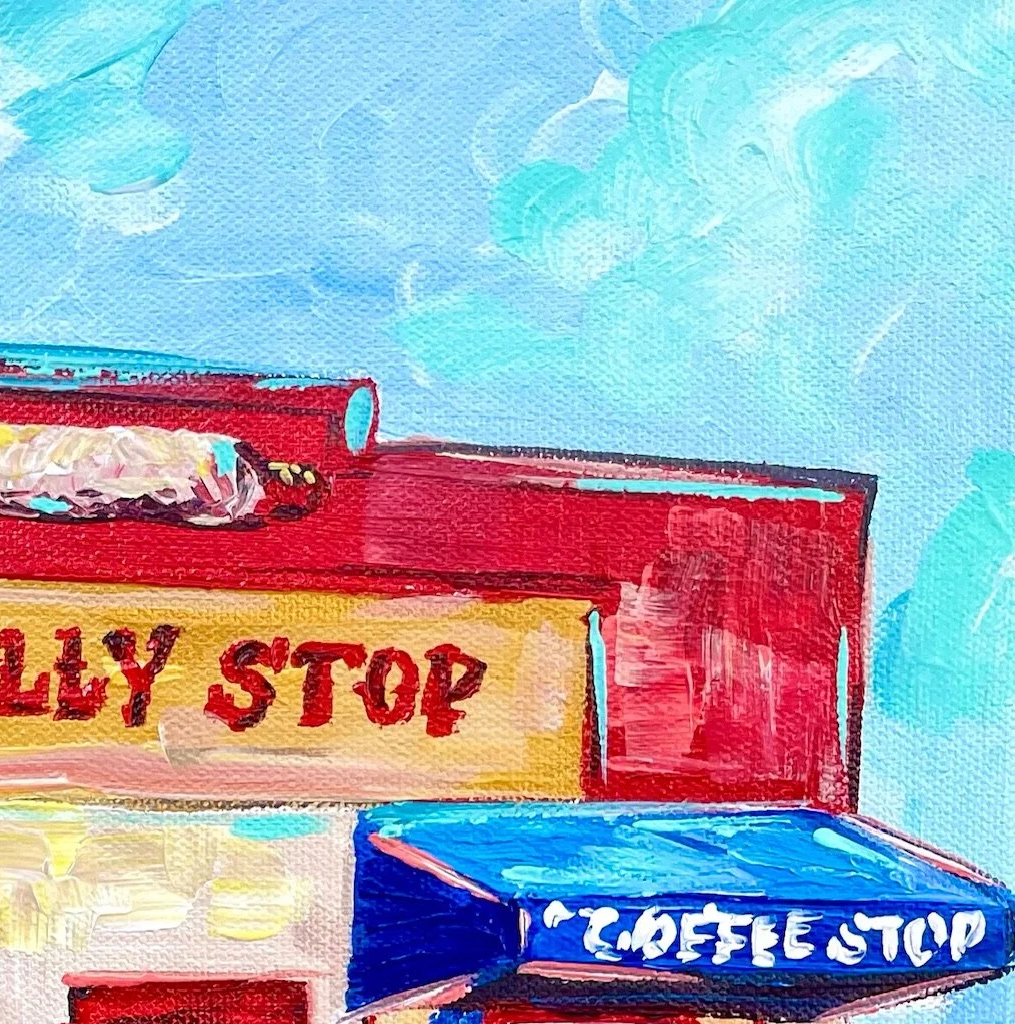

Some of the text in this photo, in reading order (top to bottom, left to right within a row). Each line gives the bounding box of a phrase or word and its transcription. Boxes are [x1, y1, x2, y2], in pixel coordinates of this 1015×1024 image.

[203, 637, 488, 737] STOP
[578, 902, 986, 967] COFFEE STOP
